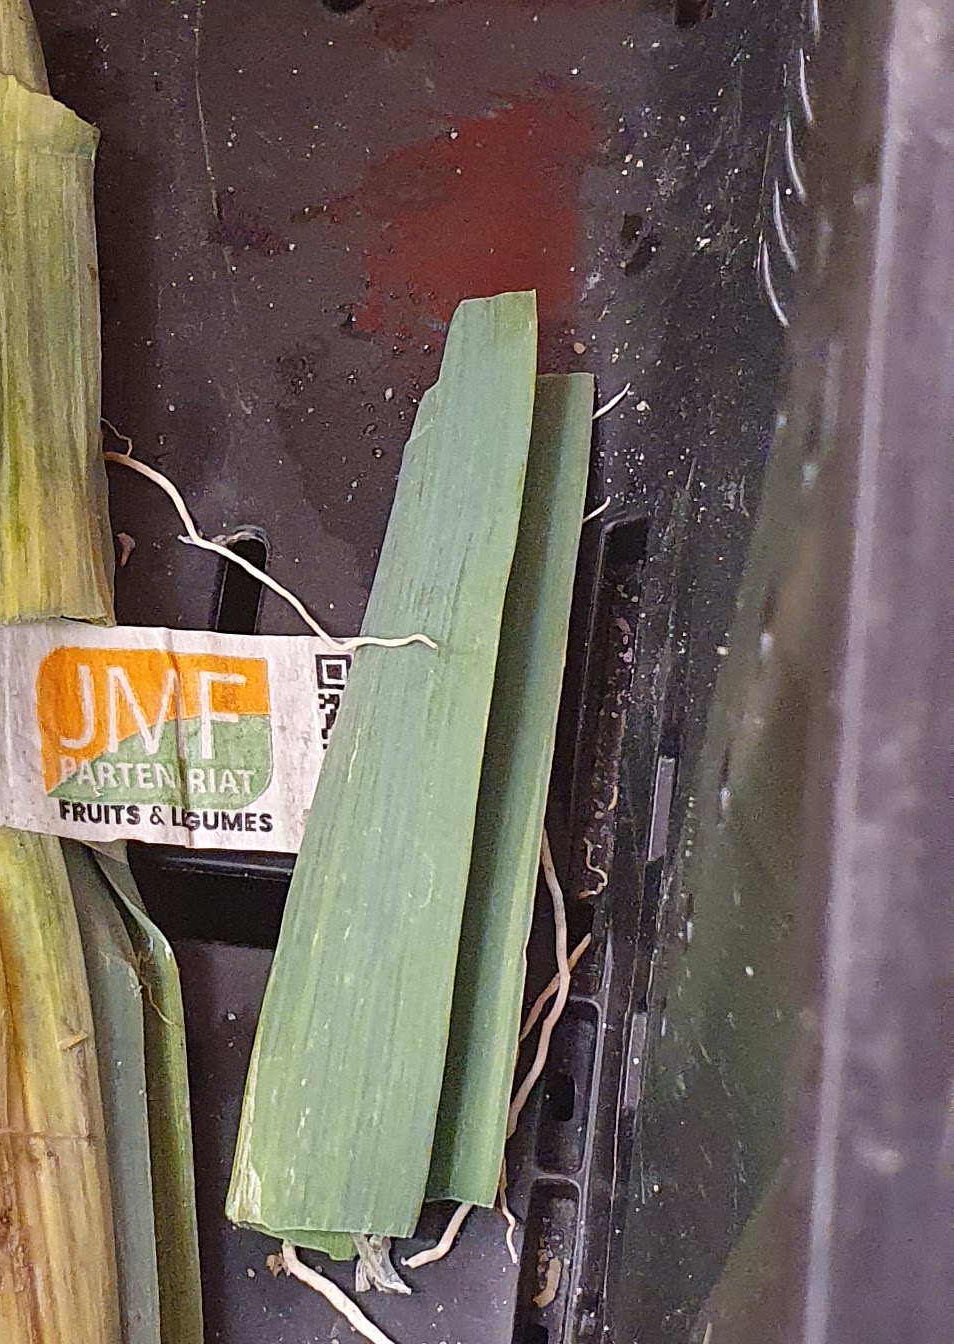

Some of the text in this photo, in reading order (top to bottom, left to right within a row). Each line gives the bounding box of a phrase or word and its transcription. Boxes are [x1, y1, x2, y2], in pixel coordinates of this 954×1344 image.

[59, 663, 248, 760] JMF
[59, 799, 141, 825] FRUITS
[149, 805, 166, 826] &
